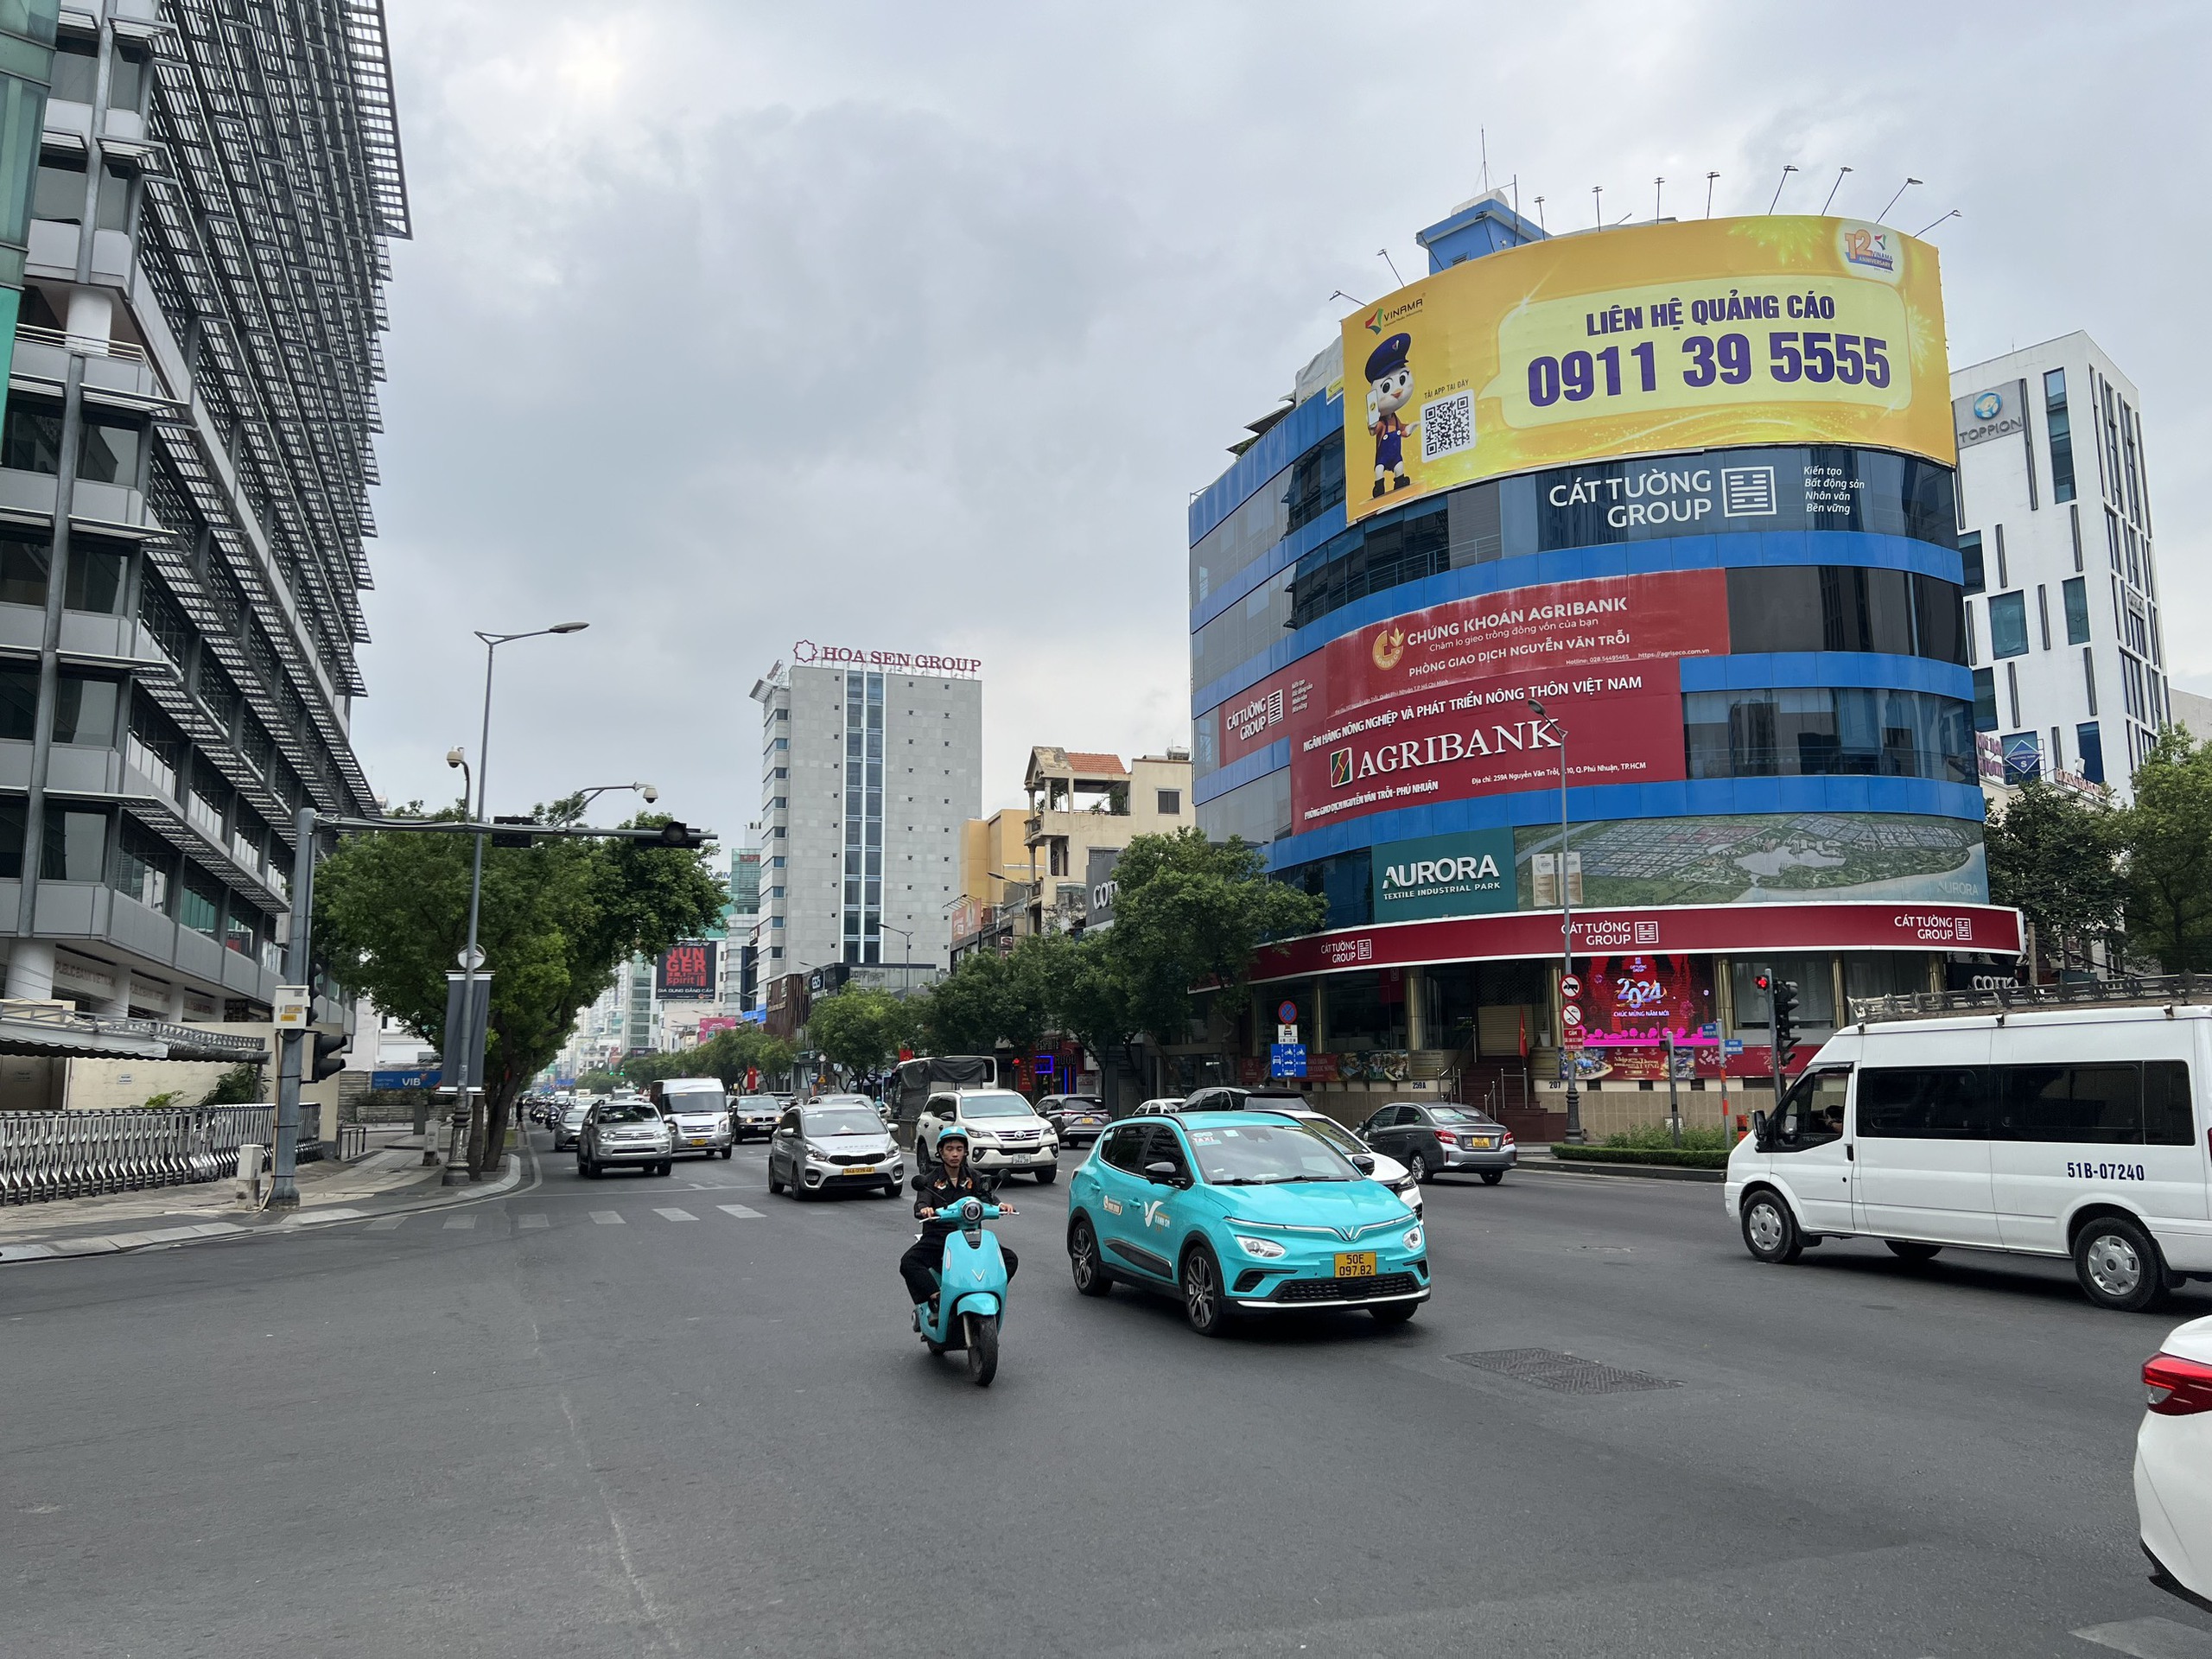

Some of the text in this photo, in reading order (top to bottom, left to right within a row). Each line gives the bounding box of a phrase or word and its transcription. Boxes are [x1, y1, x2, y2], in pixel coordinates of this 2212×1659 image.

[1845, 229, 1873, 259] 12
[1383, 298, 1423, 321] VINAMA
[1586, 289, 1834, 336] LIÊN HỆ QUẢNG CÁO
[1528, 331, 1891, 408] 0911 39 5555
[1434, 386, 1446, 396] APP
[1457, 379, 1469, 389] ĐÂY
[1959, 416, 2022, 443] TOPPION
[1803, 465, 1842, 478] Kiến tạo
[1549, 468, 1712, 507] CÁT TƯỜNG
[1804, 478, 1866, 492] Bất động sản
[1805, 490, 1851, 501] Nhân văn
[1607, 498, 1712, 529] GROUP
[1806, 502, 1851, 516] Bền vững
[1407, 597, 1628, 646] CHỨNG KHOÁN AGRIBANK
[1429, 616, 1599, 652] Chăm lo gieo trồng đồng vốn của bạn
[822, 646, 982, 671] HOA SEN GROUP
[1408, 629, 1630, 677] PHÒNG GIAO DỊCH NGUYỄN VĂN TRỖI
[1637, 648, 1710, 659] https://agriseco.com.vn
[1238, 697, 1267, 724] TƯỜNG
[1303, 676, 1643, 753] NGÂN HÀNG NÔNG NGHIỆP VÀ PHÁT TRIỂN NÔNG THÔN VIỆT NAM
[1240, 715, 1267, 741] GROUP
[1357, 718, 1561, 779] AGRIBANK
[1471, 776, 1481, 785] Địa
[1493, 773, 1508, 782] 259A
[1509, 770, 1533, 781] Nguyễn
[1533, 768, 1546, 778] Văn
[1597, 763, 1620, 774] Nhuận,
[1363, 791, 1376, 804] VĂN
[1412, 779, 1439, 794] NHUẬN
[1382, 855, 1500, 889] AURORA
[1383, 881, 1501, 900] TEXTILE INDUSTRIAL PARK
[1937, 881, 1979, 896] AURORA
[1585, 920, 1631, 933] TƯỜNG
[1894, 913, 1953, 928] CÁT TƯỜNG
[1586, 934, 1631, 946] GROUP
[1917, 928, 1954, 940] GROUP
[667, 947, 705, 960] JUN
[1320, 940, 1356, 954] CÁT TƯỜNG
[666, 959, 706, 973] GER
[1332, 951, 1357, 963] GROUP
[1617, 977, 1662, 1009] 2024
[402, 1077, 421, 1086] VIB
[2067, 1162, 2145, 1181] 51B-07240
[1346, 1254, 1364, 1264] 50E
[1339, 1265, 1372, 1276] 097.82
